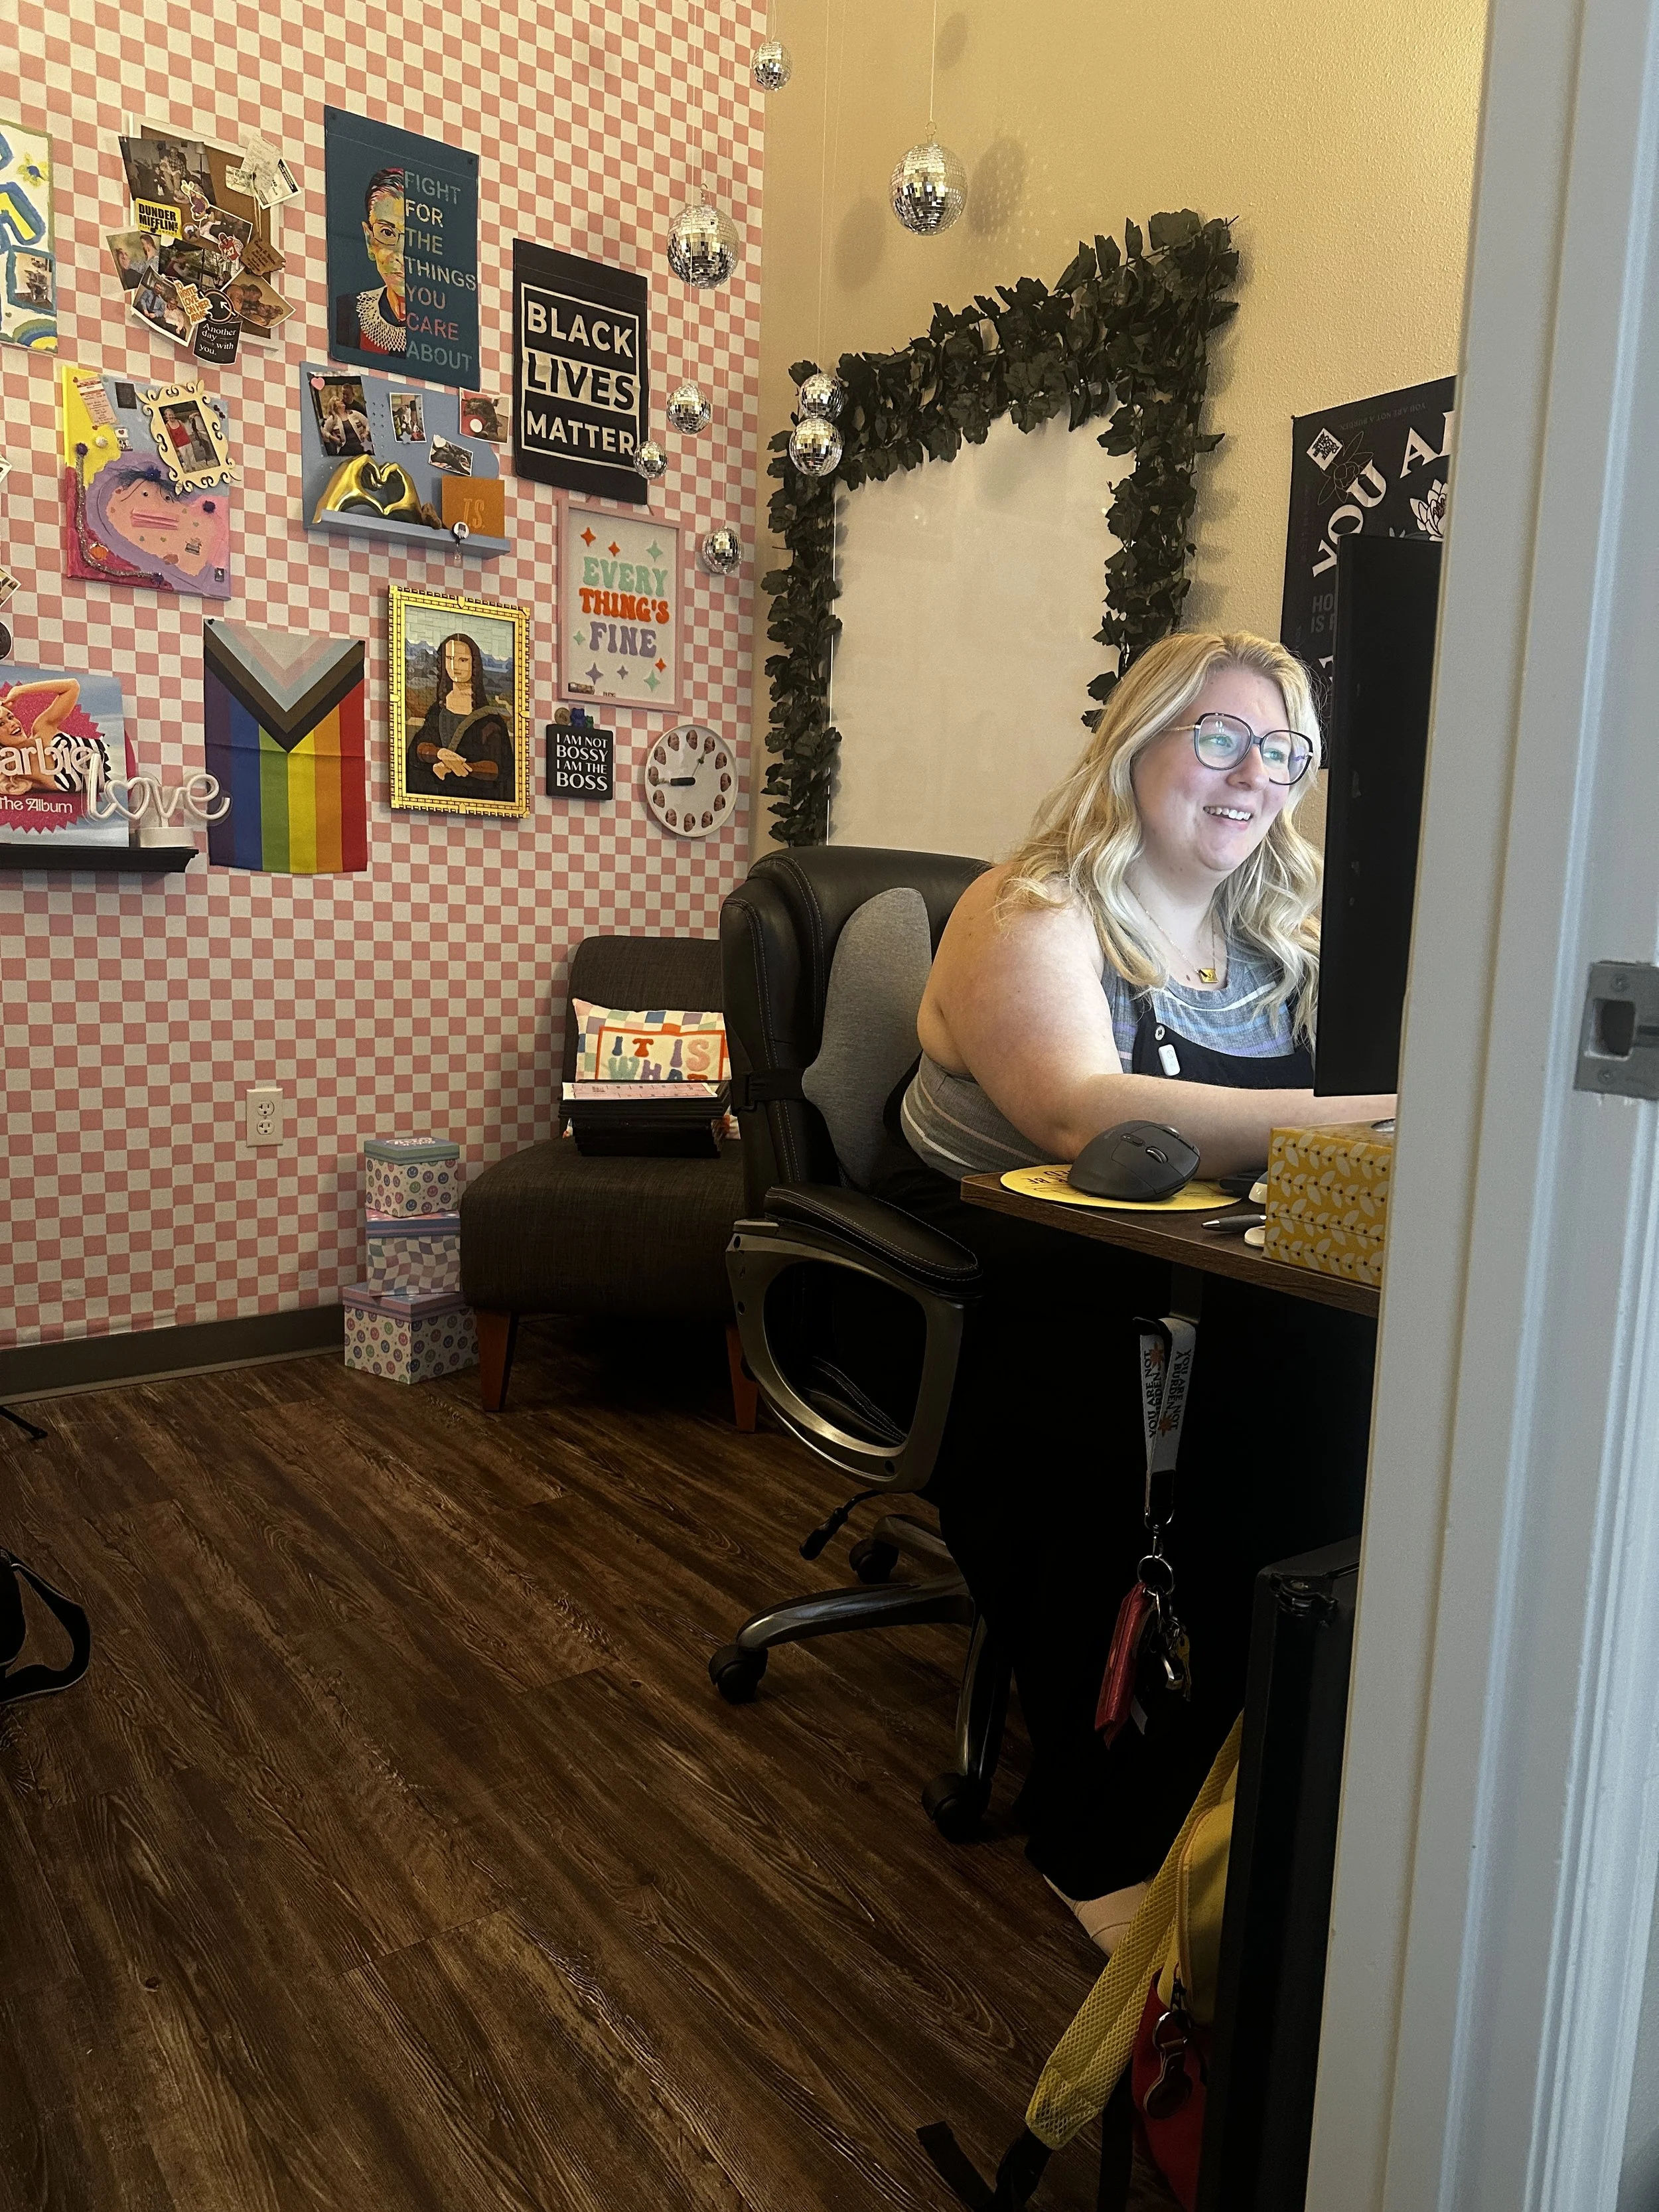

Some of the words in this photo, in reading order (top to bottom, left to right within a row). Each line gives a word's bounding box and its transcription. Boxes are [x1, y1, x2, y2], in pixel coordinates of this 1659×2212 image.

[404, 171, 461, 204] FIGHT
[139, 203, 176, 222] DUNDER
[405, 198, 443, 228] FOR
[405, 226, 443, 256] THE
[404, 256, 477, 291] THINGS
[183, 295, 199, 306] LOVE
[196, 300, 209, 311] HER
[405, 283, 446, 310] YOU
[202, 323, 237, 336] Another
[202, 331, 218, 341] day
[407, 312, 459, 341] CARE
[528, 301, 633, 358] BLACK
[199, 344, 217, 356] you.
[407, 341, 472, 372] ABOUT
[528, 352, 634, 411] LIVES
[527, 410, 634, 456] MATTER
[583, 556, 668, 597] EVERY
[579, 587, 670, 625] THING'S
[589, 621, 657, 658] FINE
[556, 745, 609, 762] BOSSY
[557, 733, 560, 743] I
[563, 734, 581, 745] AM
[585, 737, 608, 749] NOT
[557, 759, 560, 769] I
[563, 761, 581, 772] AM
[585, 763, 607, 774] THE
[556, 771, 608, 791] BOSS
[26, 798, 72, 813] Album
[612, 1036, 654, 1057] IT
[670, 1038, 711, 1072] IS
[1176, 1351, 1185, 1361] A
[1181, 1349, 1192, 1375] YOU
[1146, 1382, 1155, 1406] ARE
[1172, 1404, 1181, 1431] NOT
